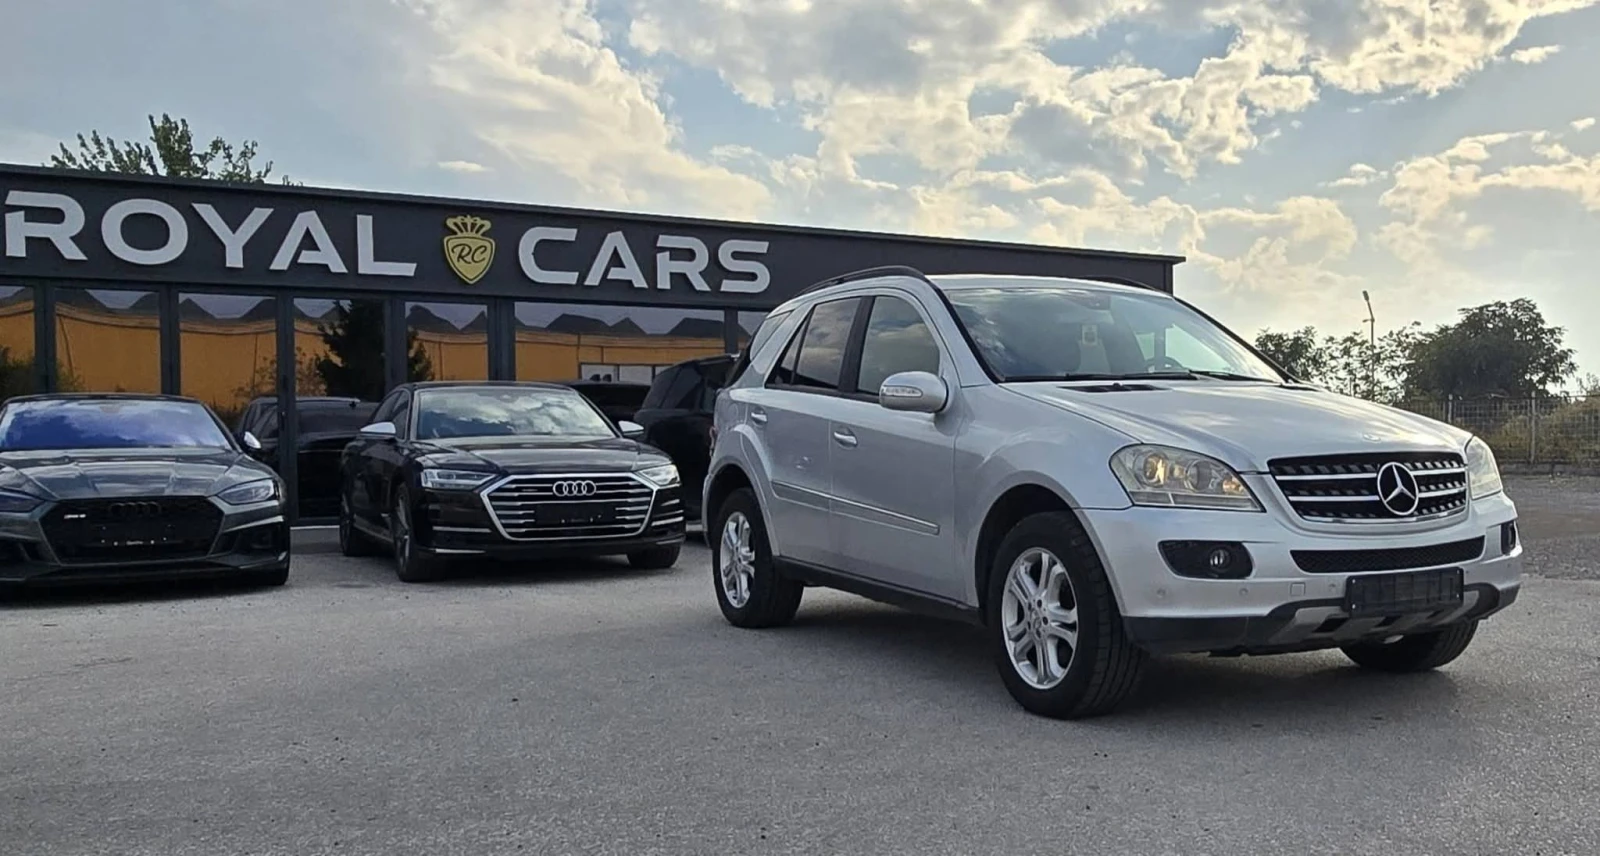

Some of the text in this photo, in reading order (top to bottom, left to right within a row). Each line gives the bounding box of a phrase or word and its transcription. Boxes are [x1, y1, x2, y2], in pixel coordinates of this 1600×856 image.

[5, 190, 771, 293] ROYAL CARS
[451, 243, 487, 264] RC
